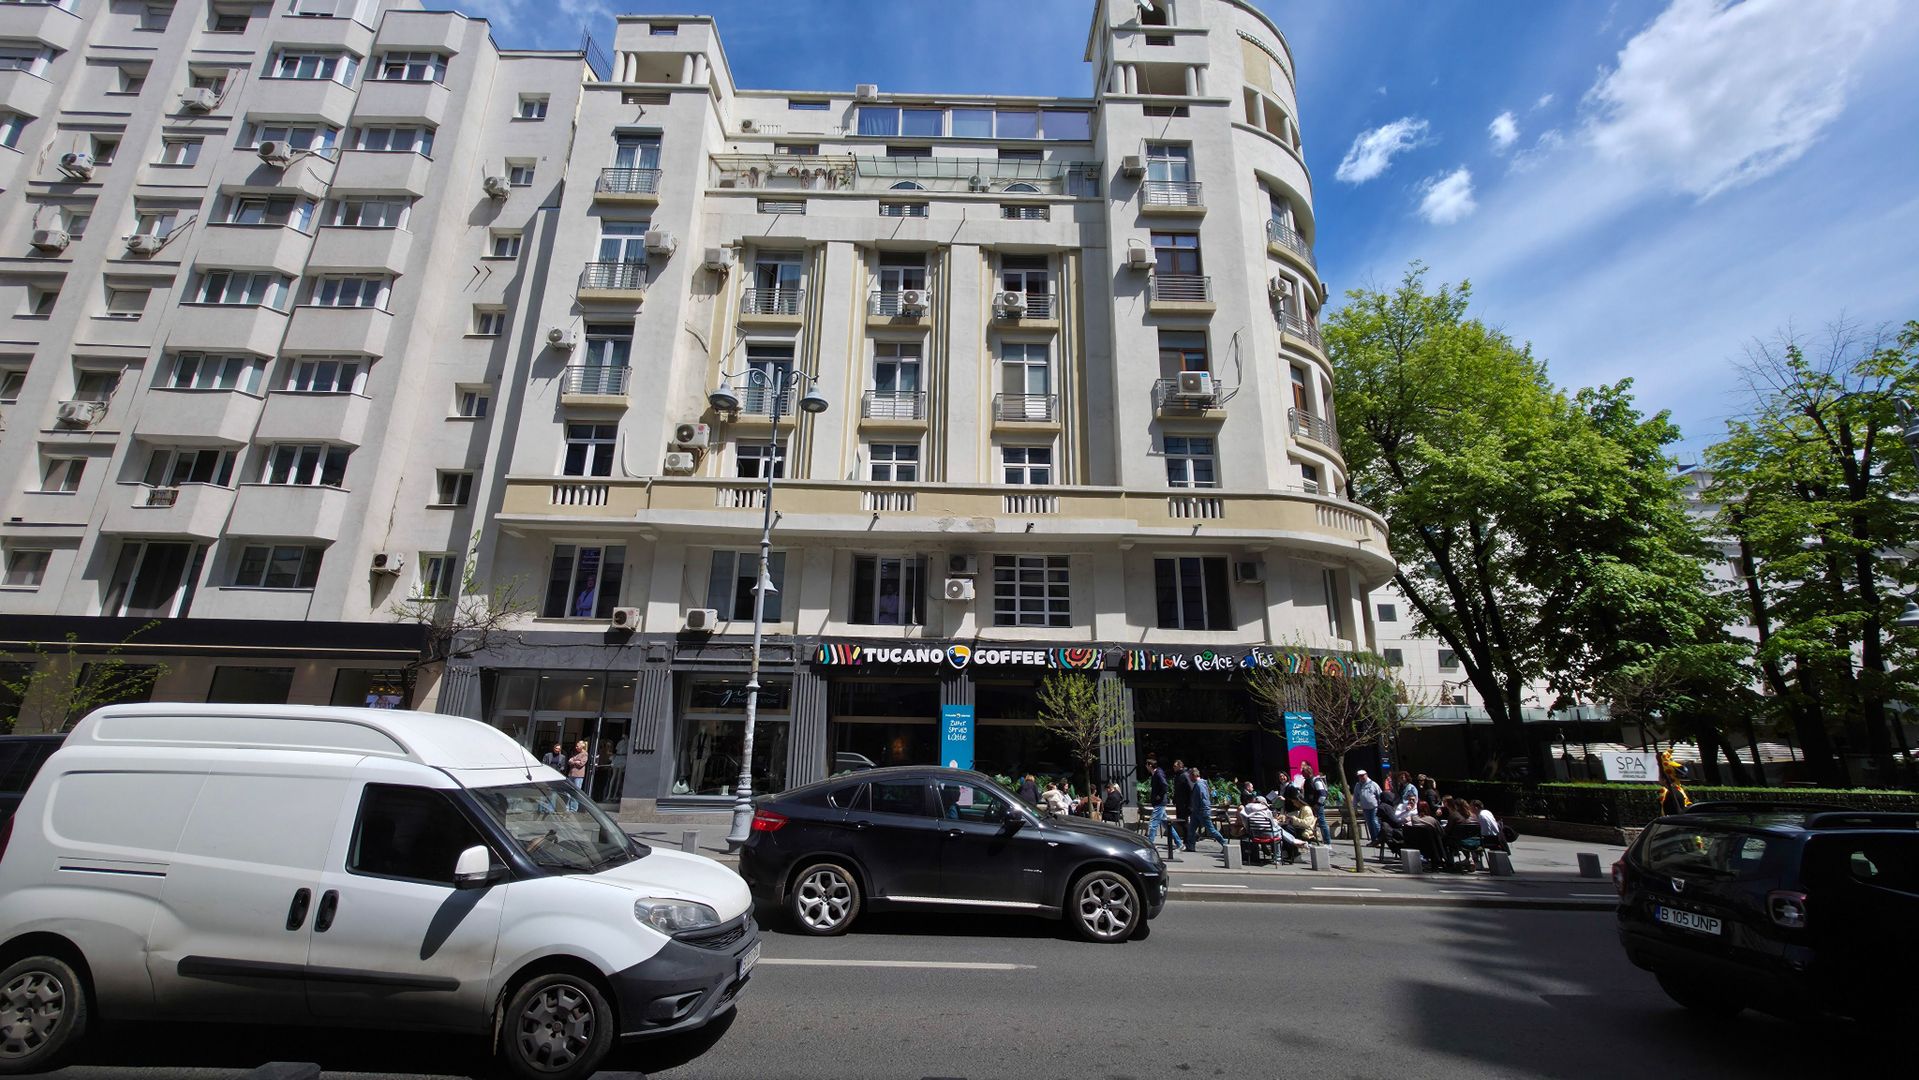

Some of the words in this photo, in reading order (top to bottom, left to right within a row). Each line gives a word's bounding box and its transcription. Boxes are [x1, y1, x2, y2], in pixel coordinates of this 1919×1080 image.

[863, 647, 944, 664] TUCANO
[973, 649, 1046, 665] COFFEE
[1616, 756, 1646, 770] SPA
[1661, 908, 1669, 920] B
[1673, 910, 1689, 925] 105
[1691, 914, 1718, 931] UNP
